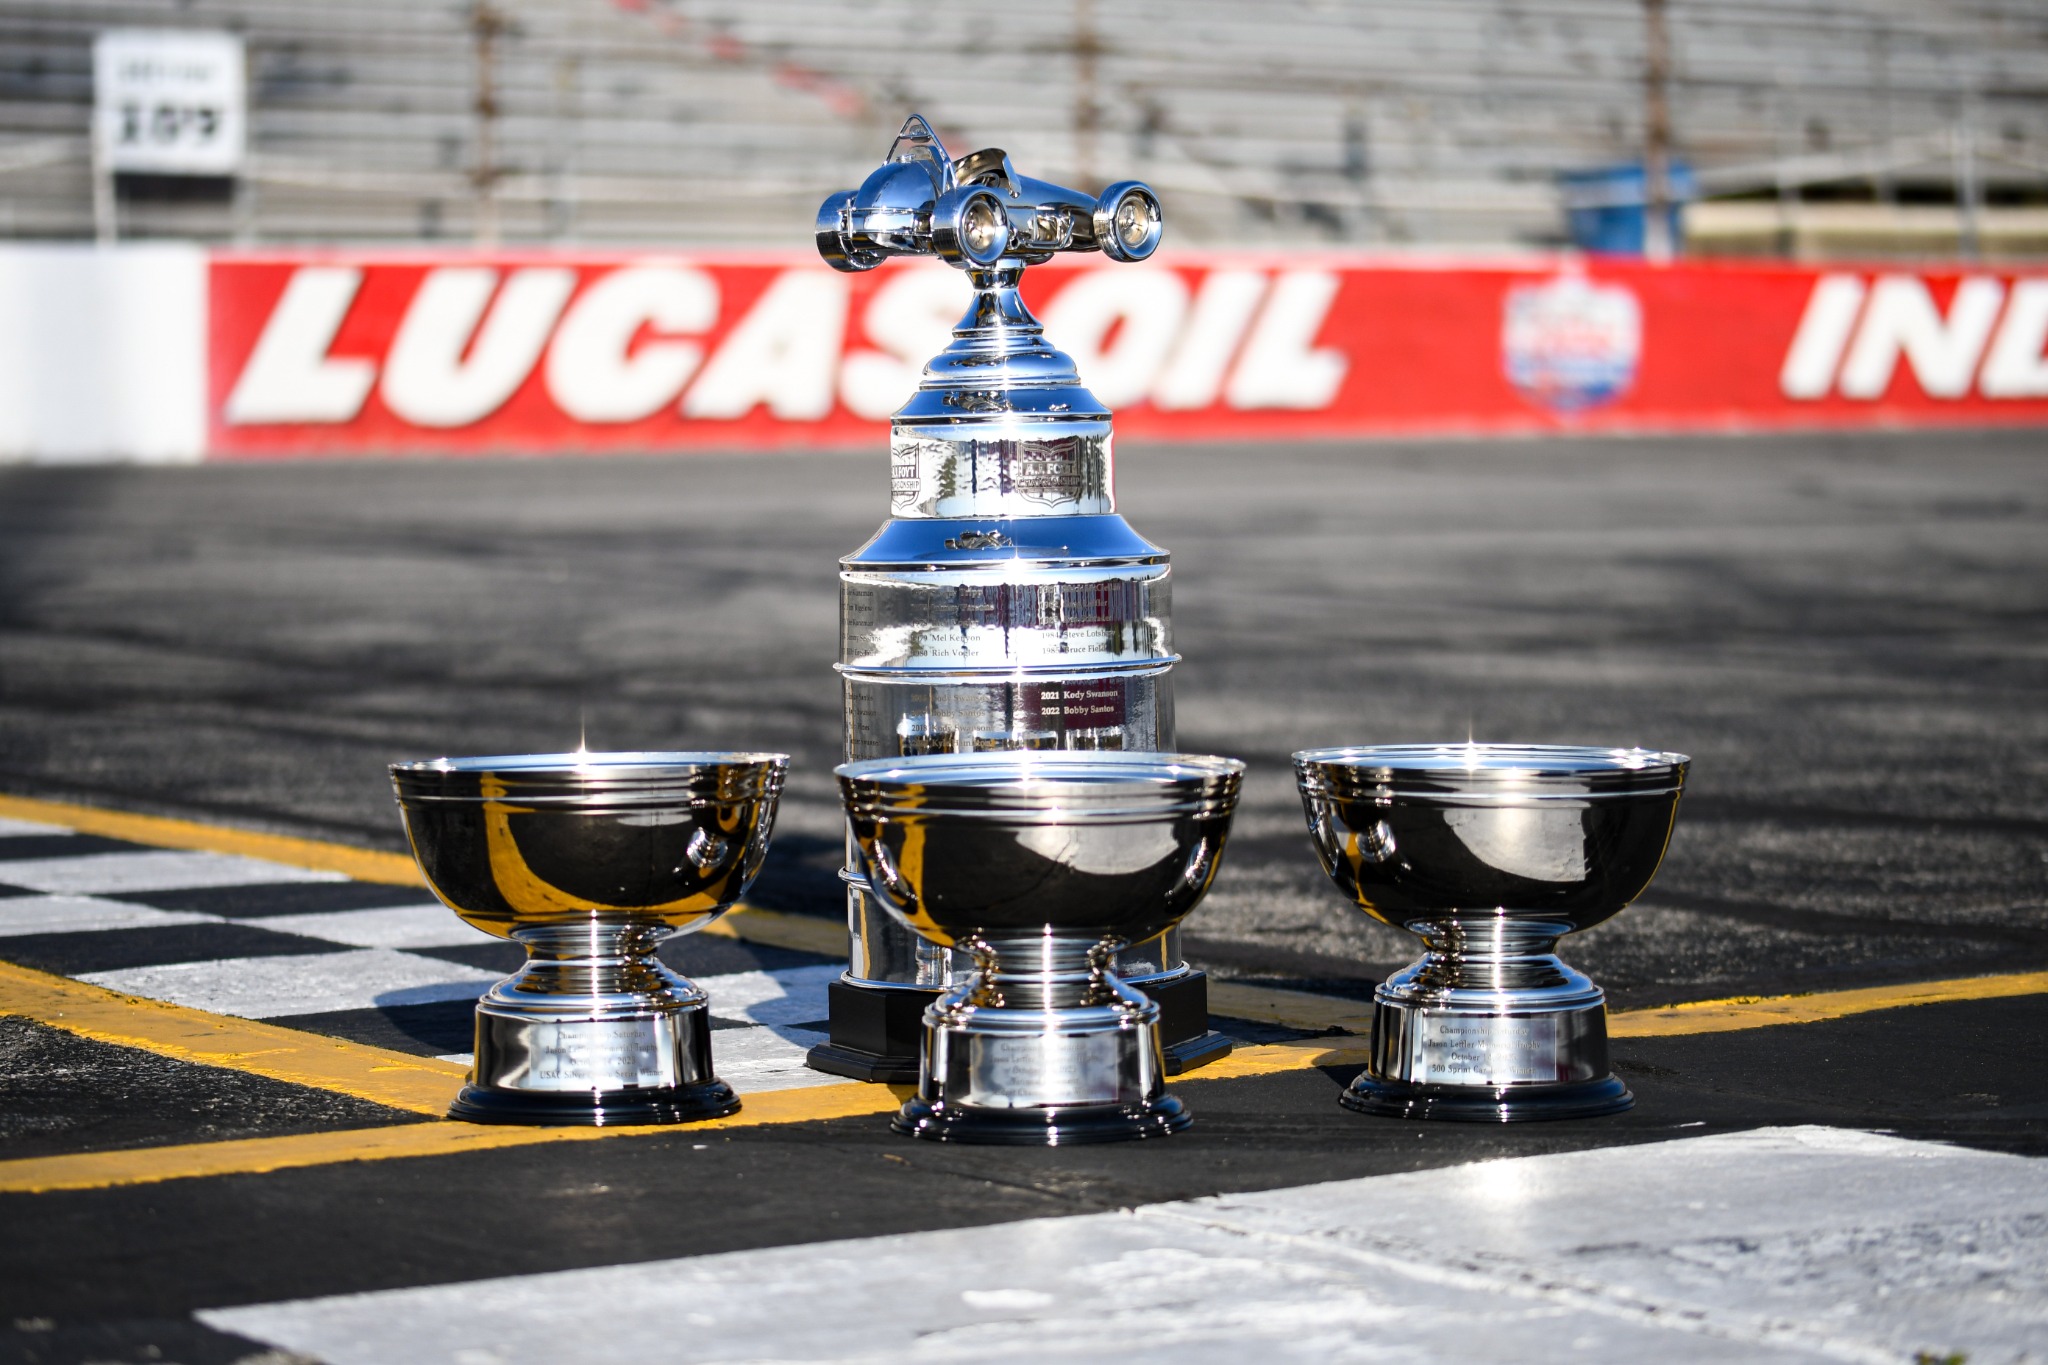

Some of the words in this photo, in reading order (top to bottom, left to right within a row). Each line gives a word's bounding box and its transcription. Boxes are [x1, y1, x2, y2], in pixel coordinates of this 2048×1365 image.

[224, 263, 967, 430] LUCAS
[1041, 267, 1348, 413] OIL
[898, 466, 915, 478] FOYT
[1047, 463, 1074, 475] FOYT
[949, 634, 981, 644] Kenyon
[1063, 630, 1085, 639] Steve
[932, 649, 949, 657] Rich
[952, 649, 979, 659] Vogler
[1064, 645, 1086, 653] Bruce
[1041, 691, 1060, 700] 2021
[1063, 690, 1085, 701] Kody
[1086, 689, 1118, 698] Swanson
[1041, 706, 1060, 715] 2022
[1064, 705, 1089, 716] Bobby
[1091, 704, 1115, 714] Santos
[1440, 1025, 1491, 1036] Championship
[1428, 1039, 1448, 1048] Jason
[1450, 1039, 1475, 1049] Leffler
[1451, 1051, 1480, 1061] October
[1431, 1064, 1446, 1073] 500
[1448, 1064, 1471, 1075] Sprint
[1473, 1065, 1487, 1074] Car
